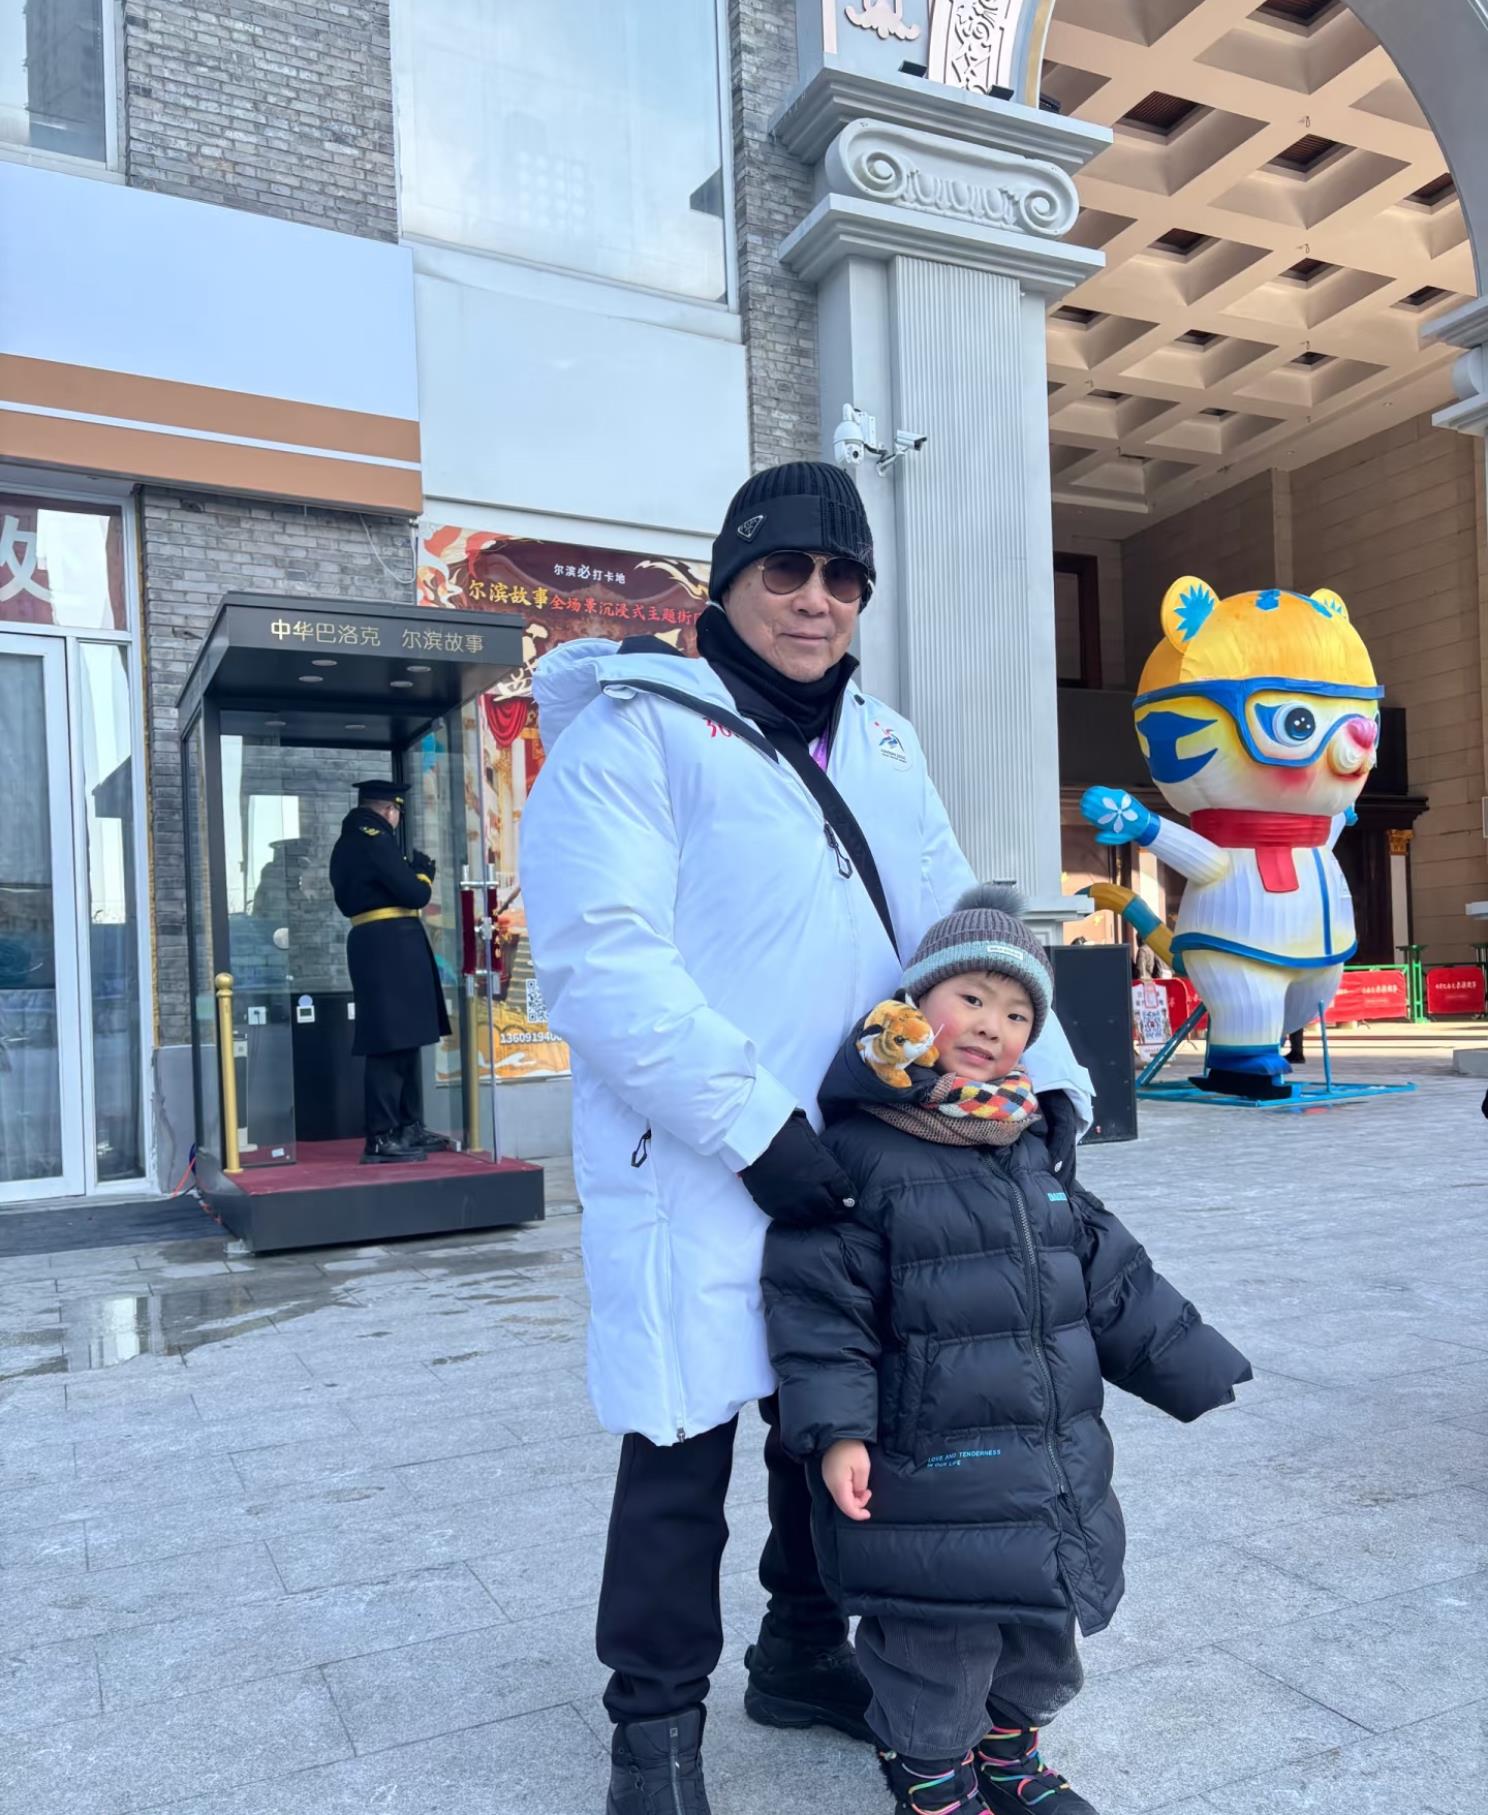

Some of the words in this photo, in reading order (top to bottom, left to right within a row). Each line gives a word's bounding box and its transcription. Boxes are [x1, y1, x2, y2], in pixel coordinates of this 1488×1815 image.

[553, 563, 626, 585] 尔滨必打卡地
[469, 579, 549, 610] 尔滨故事
[271, 618, 381, 648] 中华巴洛克
[401, 628, 485, 653] 尔滨故事
[959, 1449, 1001, 1458] TENDERNESS
